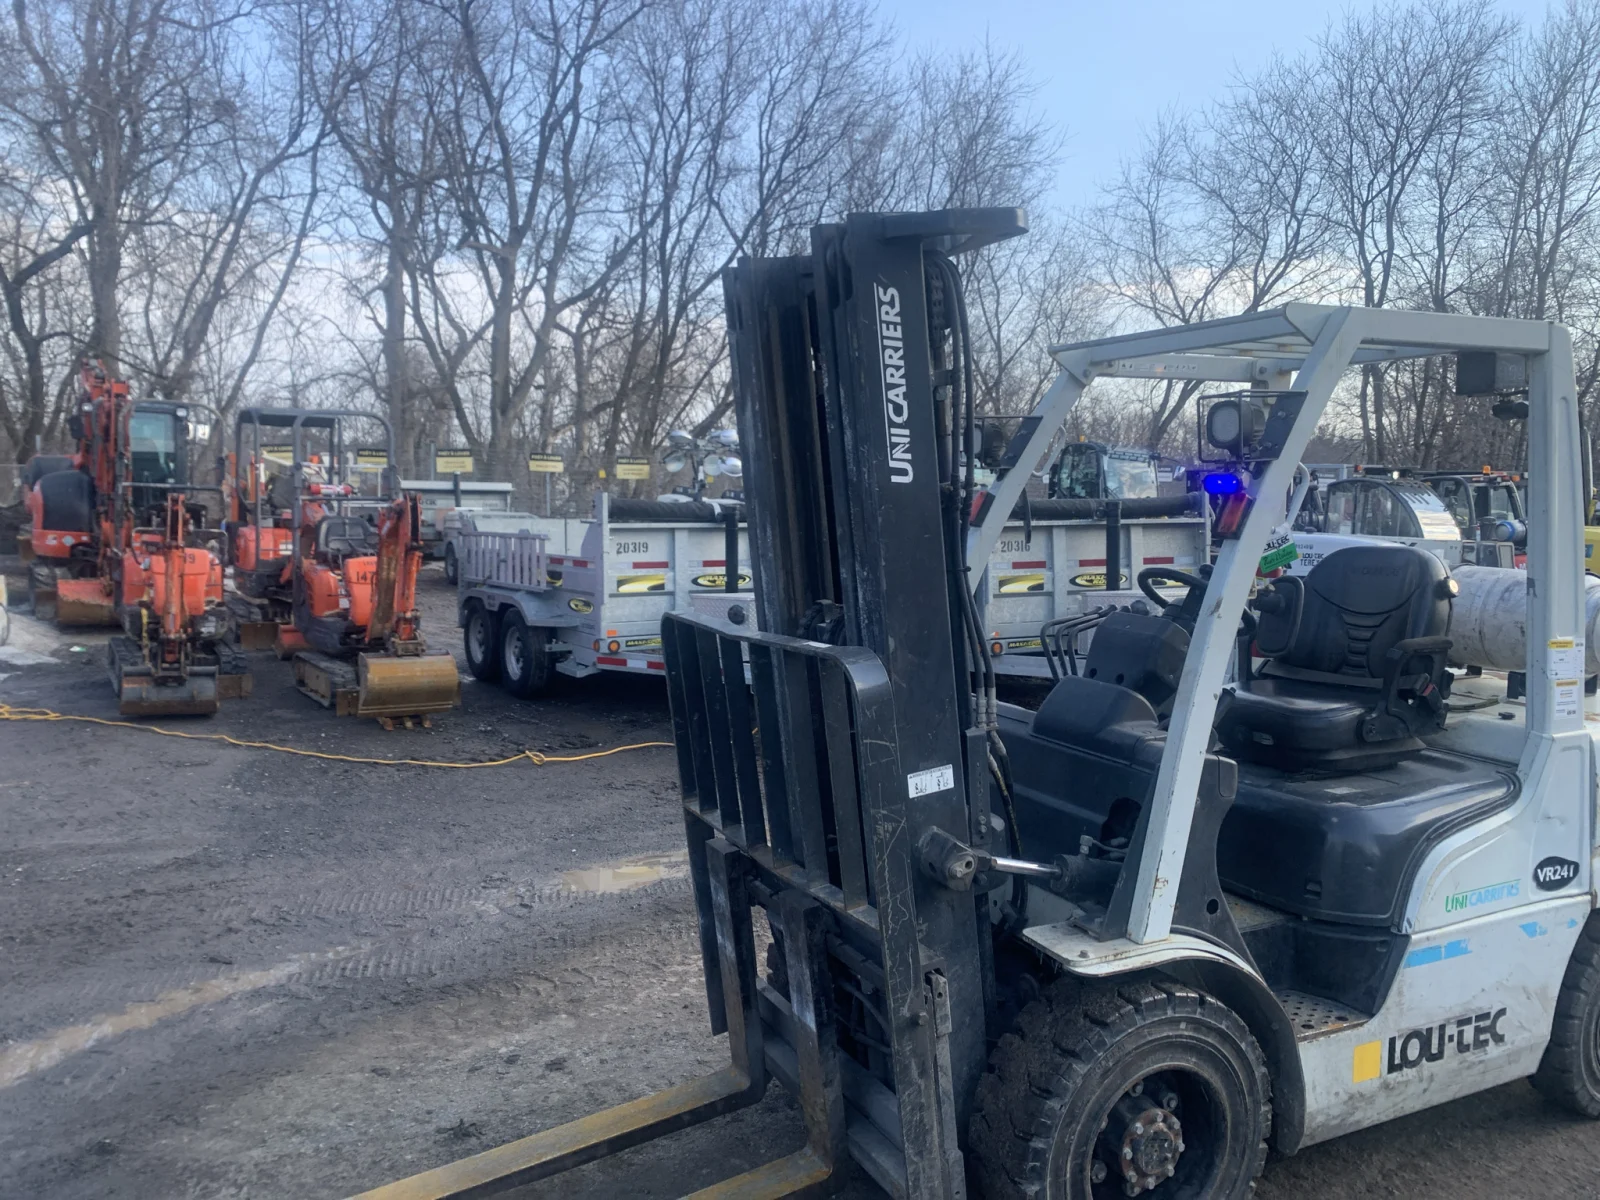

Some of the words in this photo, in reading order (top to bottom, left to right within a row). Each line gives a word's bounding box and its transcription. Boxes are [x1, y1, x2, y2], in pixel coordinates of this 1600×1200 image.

[616, 541, 649, 555] 20319
[1537, 865, 1575, 882] VR241
[1387, 1007, 1508, 1075] LOU-TEC
